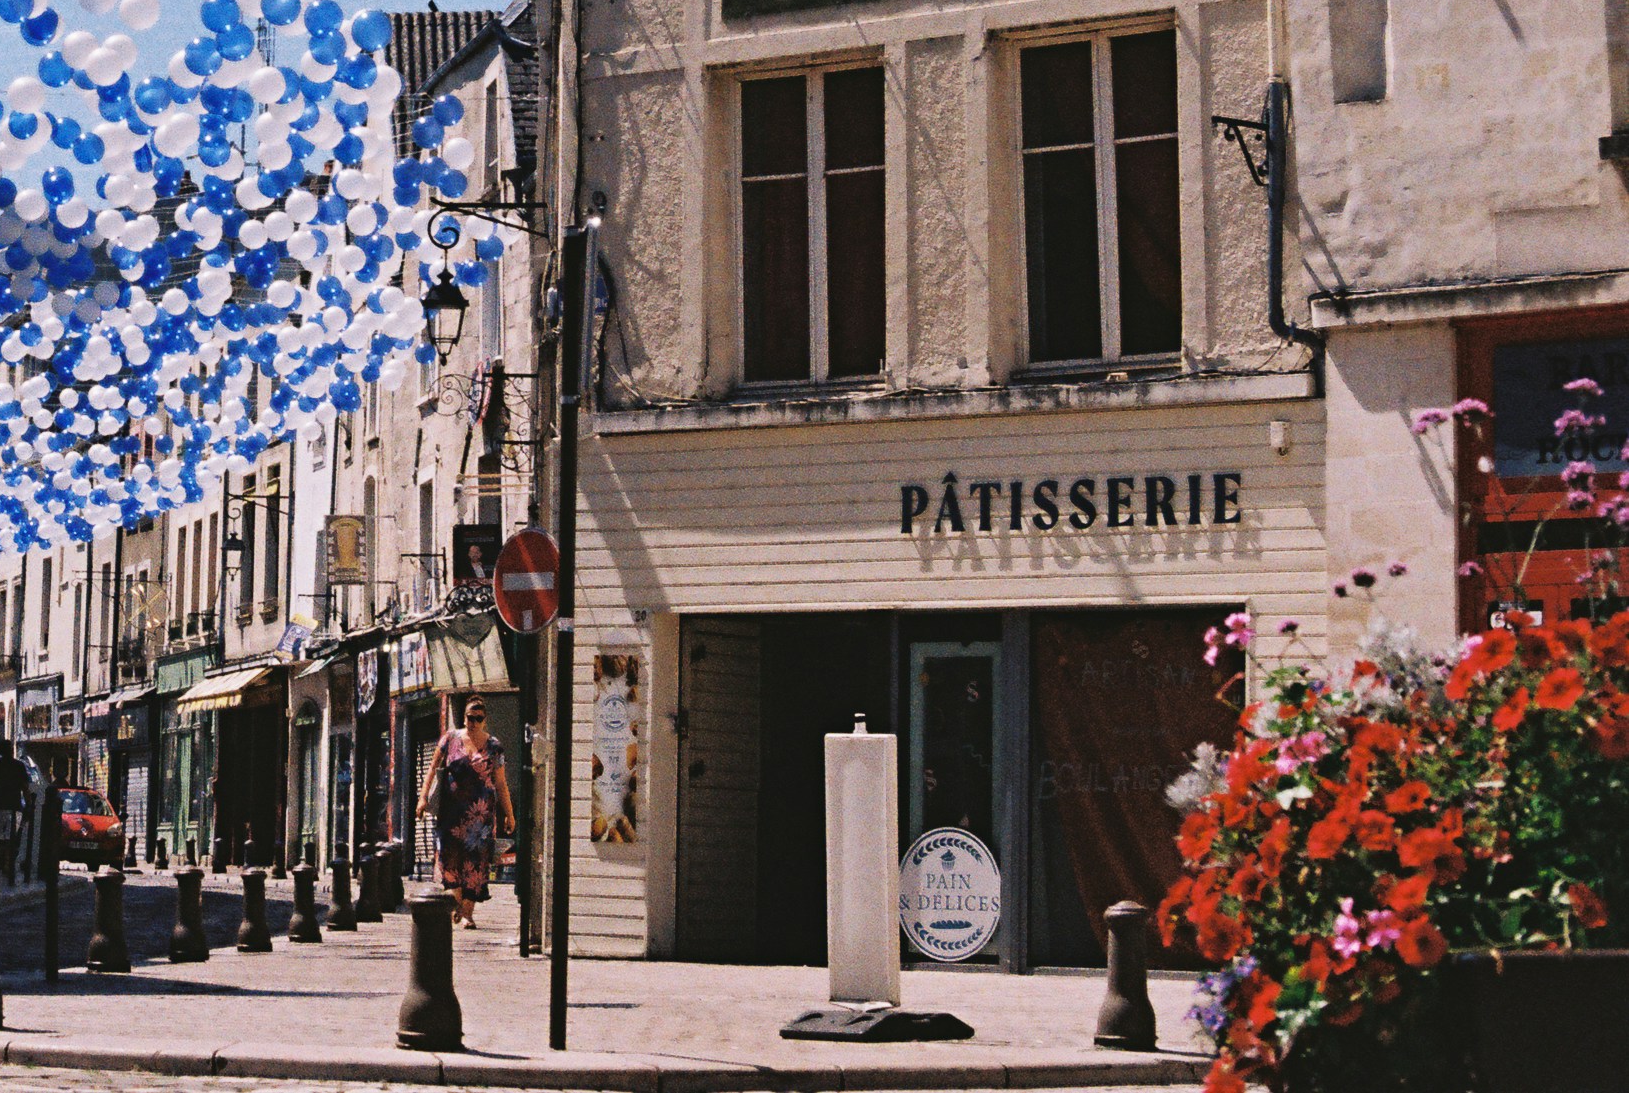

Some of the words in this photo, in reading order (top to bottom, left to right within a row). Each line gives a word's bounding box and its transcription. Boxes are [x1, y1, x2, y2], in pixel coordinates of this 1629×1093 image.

[900, 471, 1242, 534] PÂTISSERIE
[635, 610, 646, 622] 20
[926, 873, 971, 889] PAIN
[900, 894, 910, 911] &
